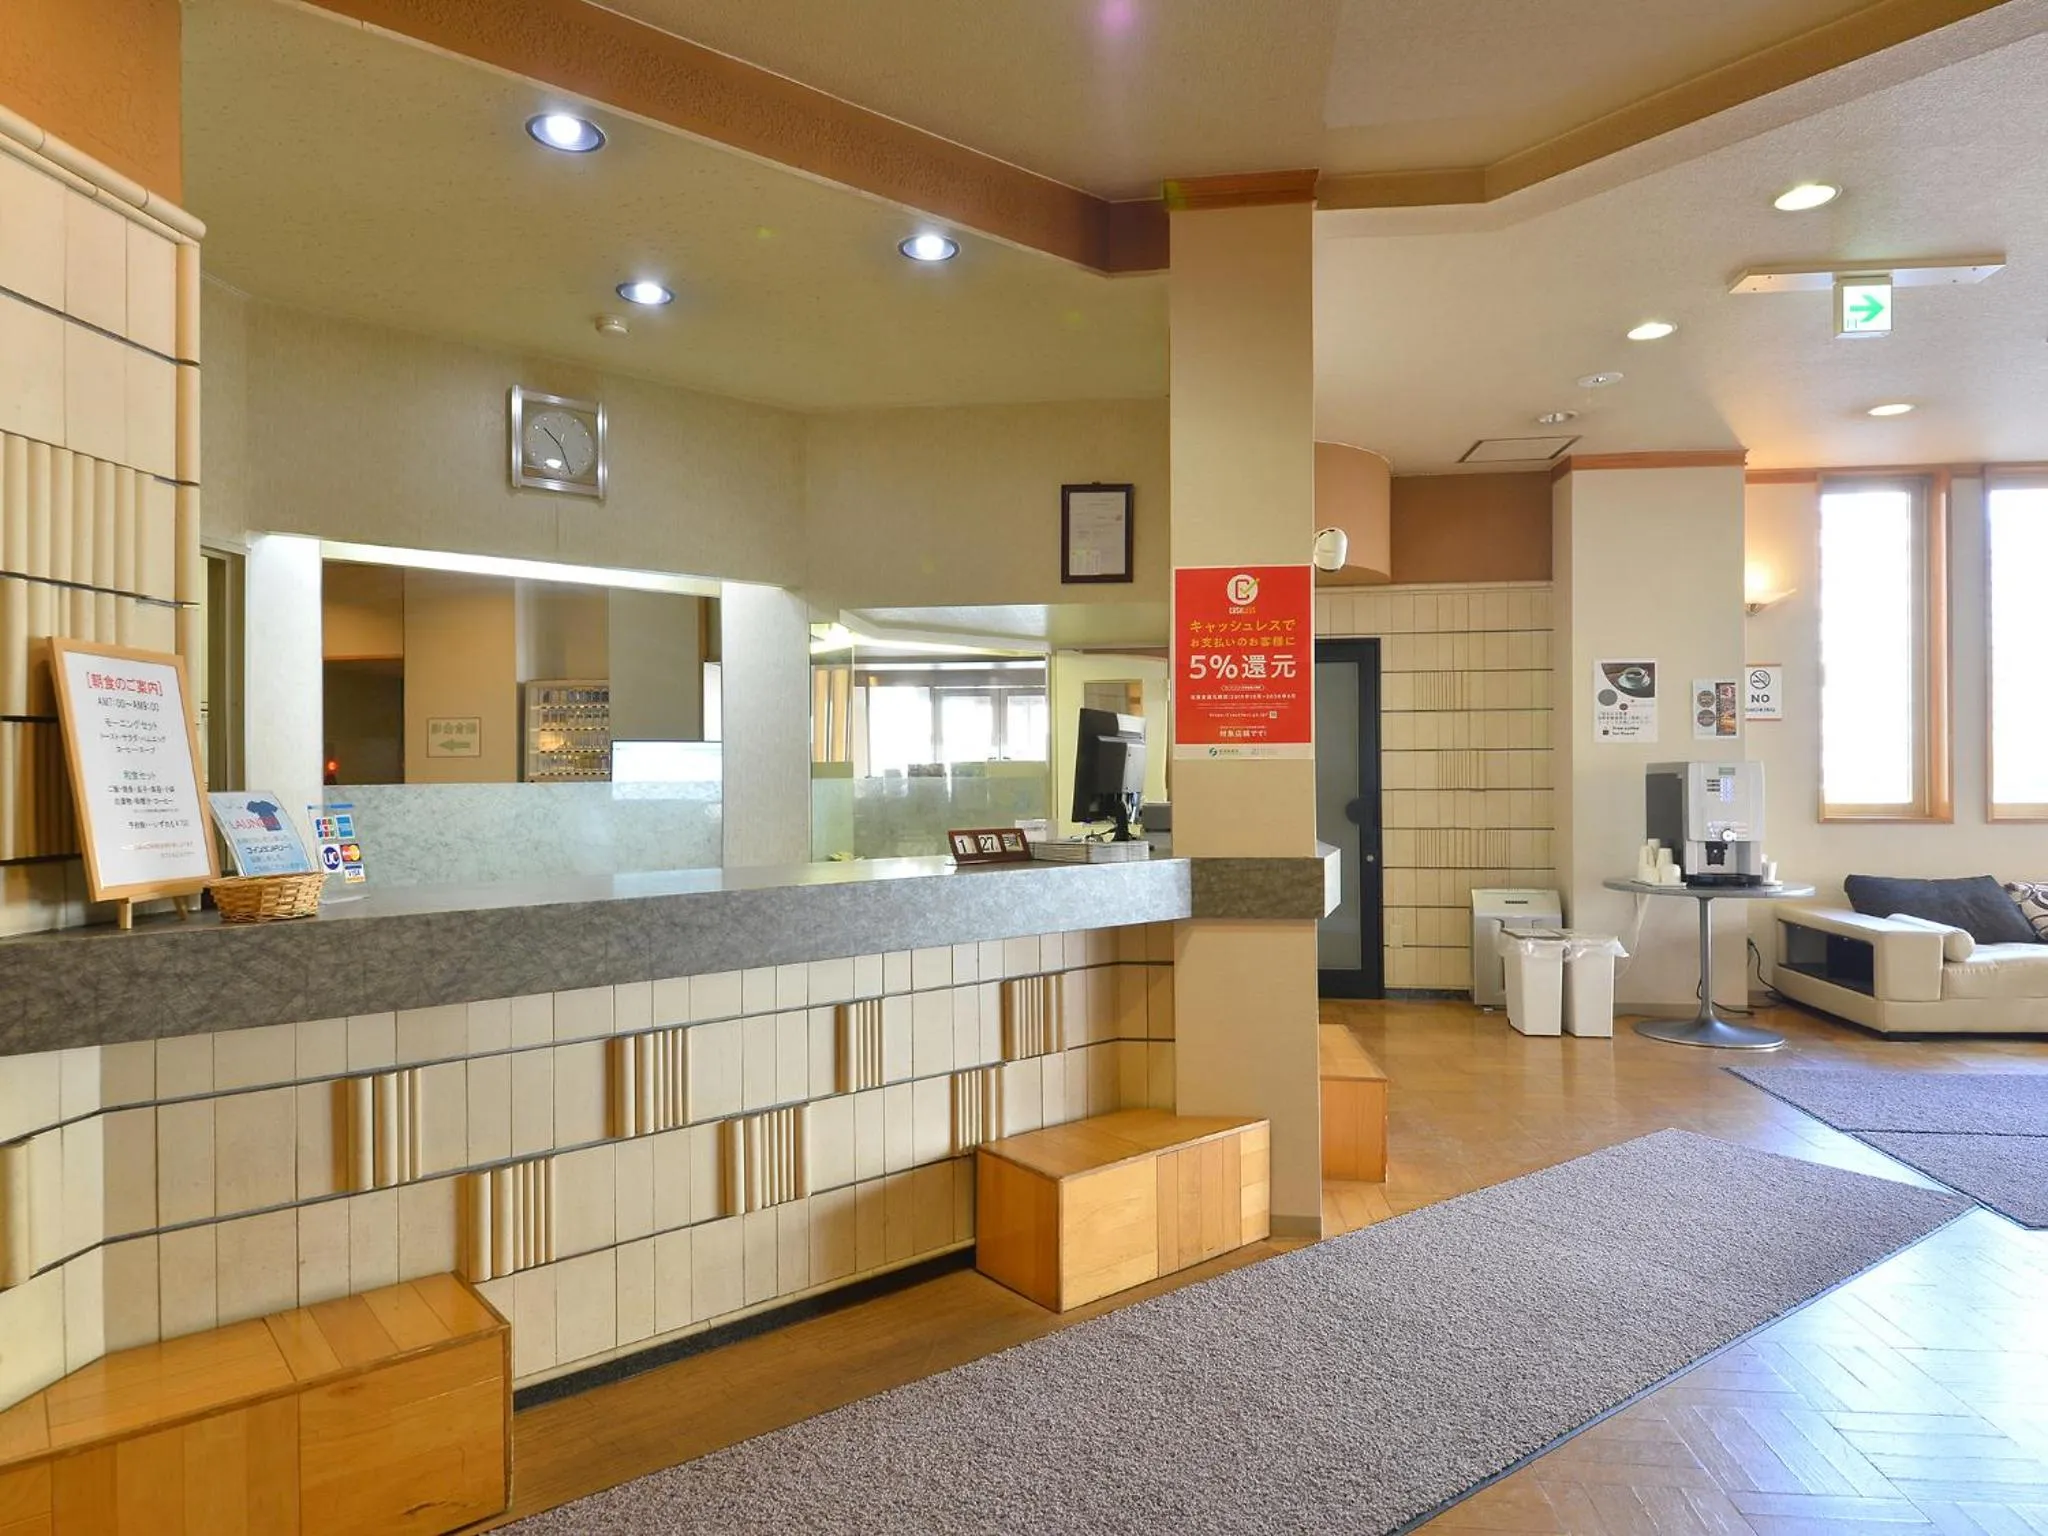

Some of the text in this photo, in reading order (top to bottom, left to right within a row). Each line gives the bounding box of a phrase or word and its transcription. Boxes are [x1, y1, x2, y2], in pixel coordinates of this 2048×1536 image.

[1190, 619, 1296, 632] キャッシュレスで
[1190, 636, 1296, 648] お支払いのお客様に
[1190, 654, 1297, 679] 5%還元
[1751, 694, 1770, 703] NO
[958, 839, 967, 853] 1
[979, 836, 995, 851] 27
